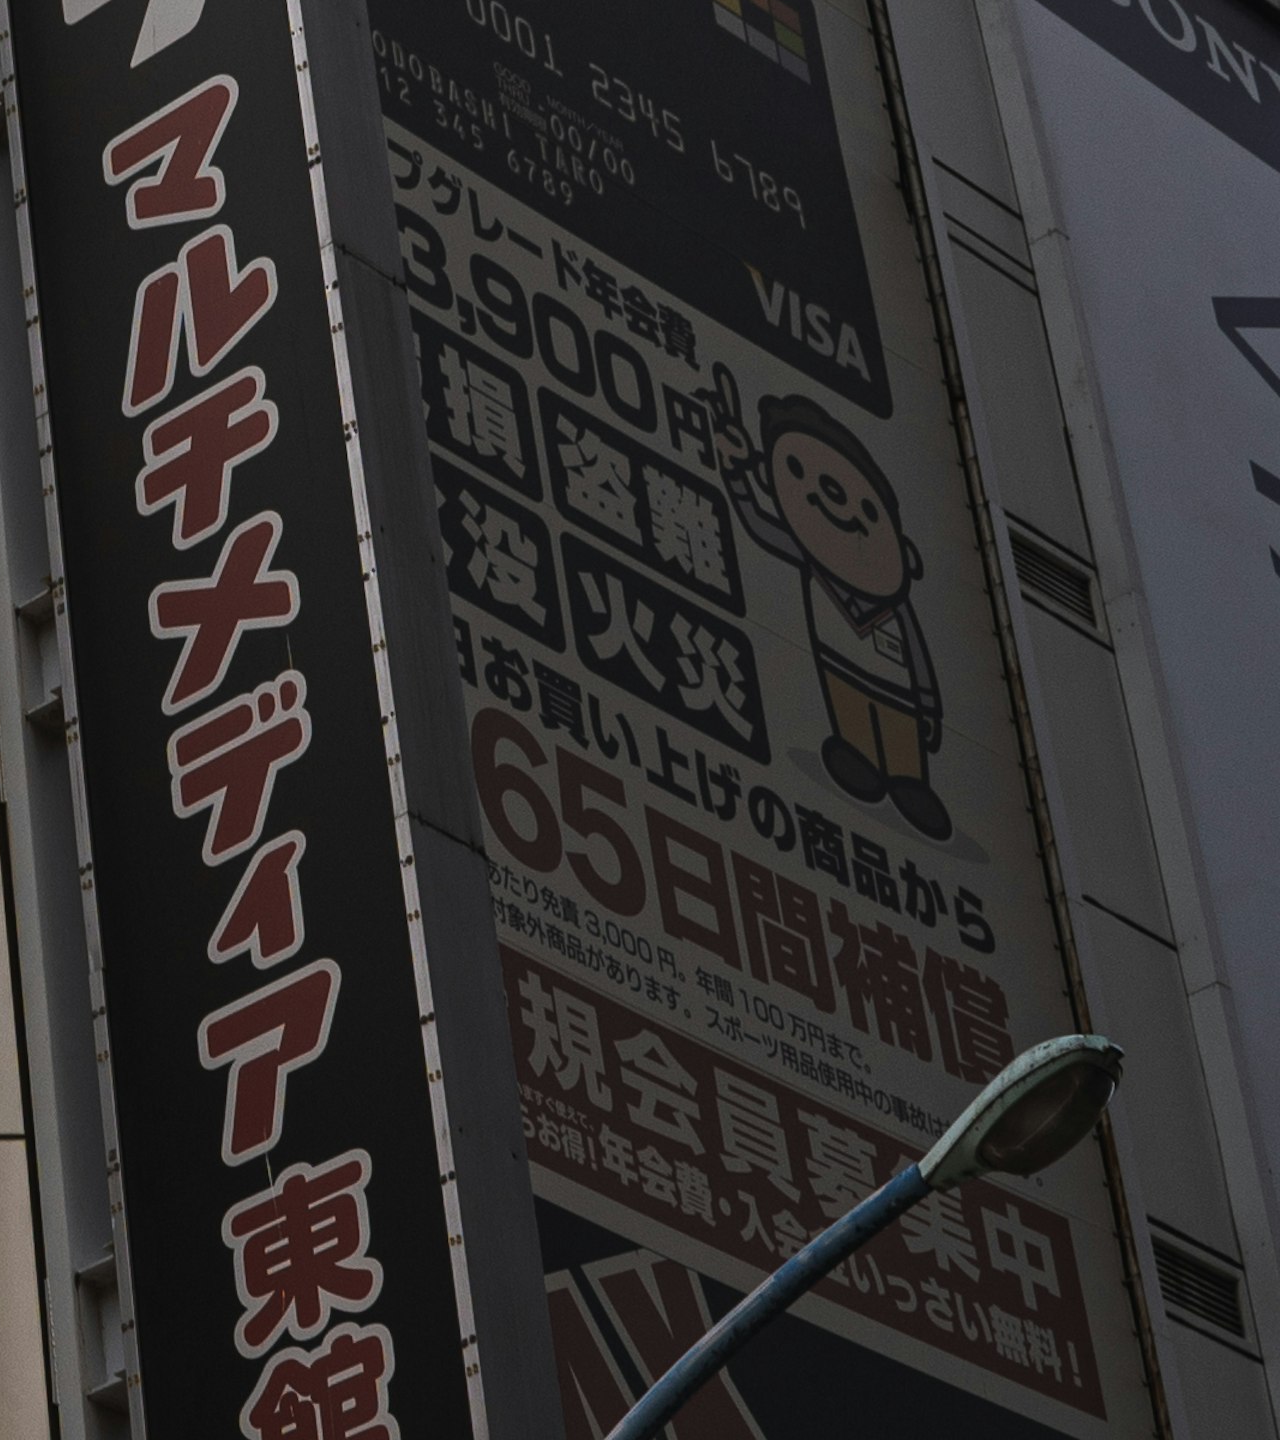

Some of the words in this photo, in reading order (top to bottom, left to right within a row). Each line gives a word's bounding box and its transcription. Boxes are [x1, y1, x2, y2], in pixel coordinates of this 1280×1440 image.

[371, 28, 512, 141] ODOBASHI
[535, 132, 604, 196] TARO
[588, 61, 686, 154] 2345
[710, 138, 807, 230] 6789
[748, 265, 868, 380] VISA
[552, 412, 732, 582] 盗難
[572, 568, 753, 740] 火災
